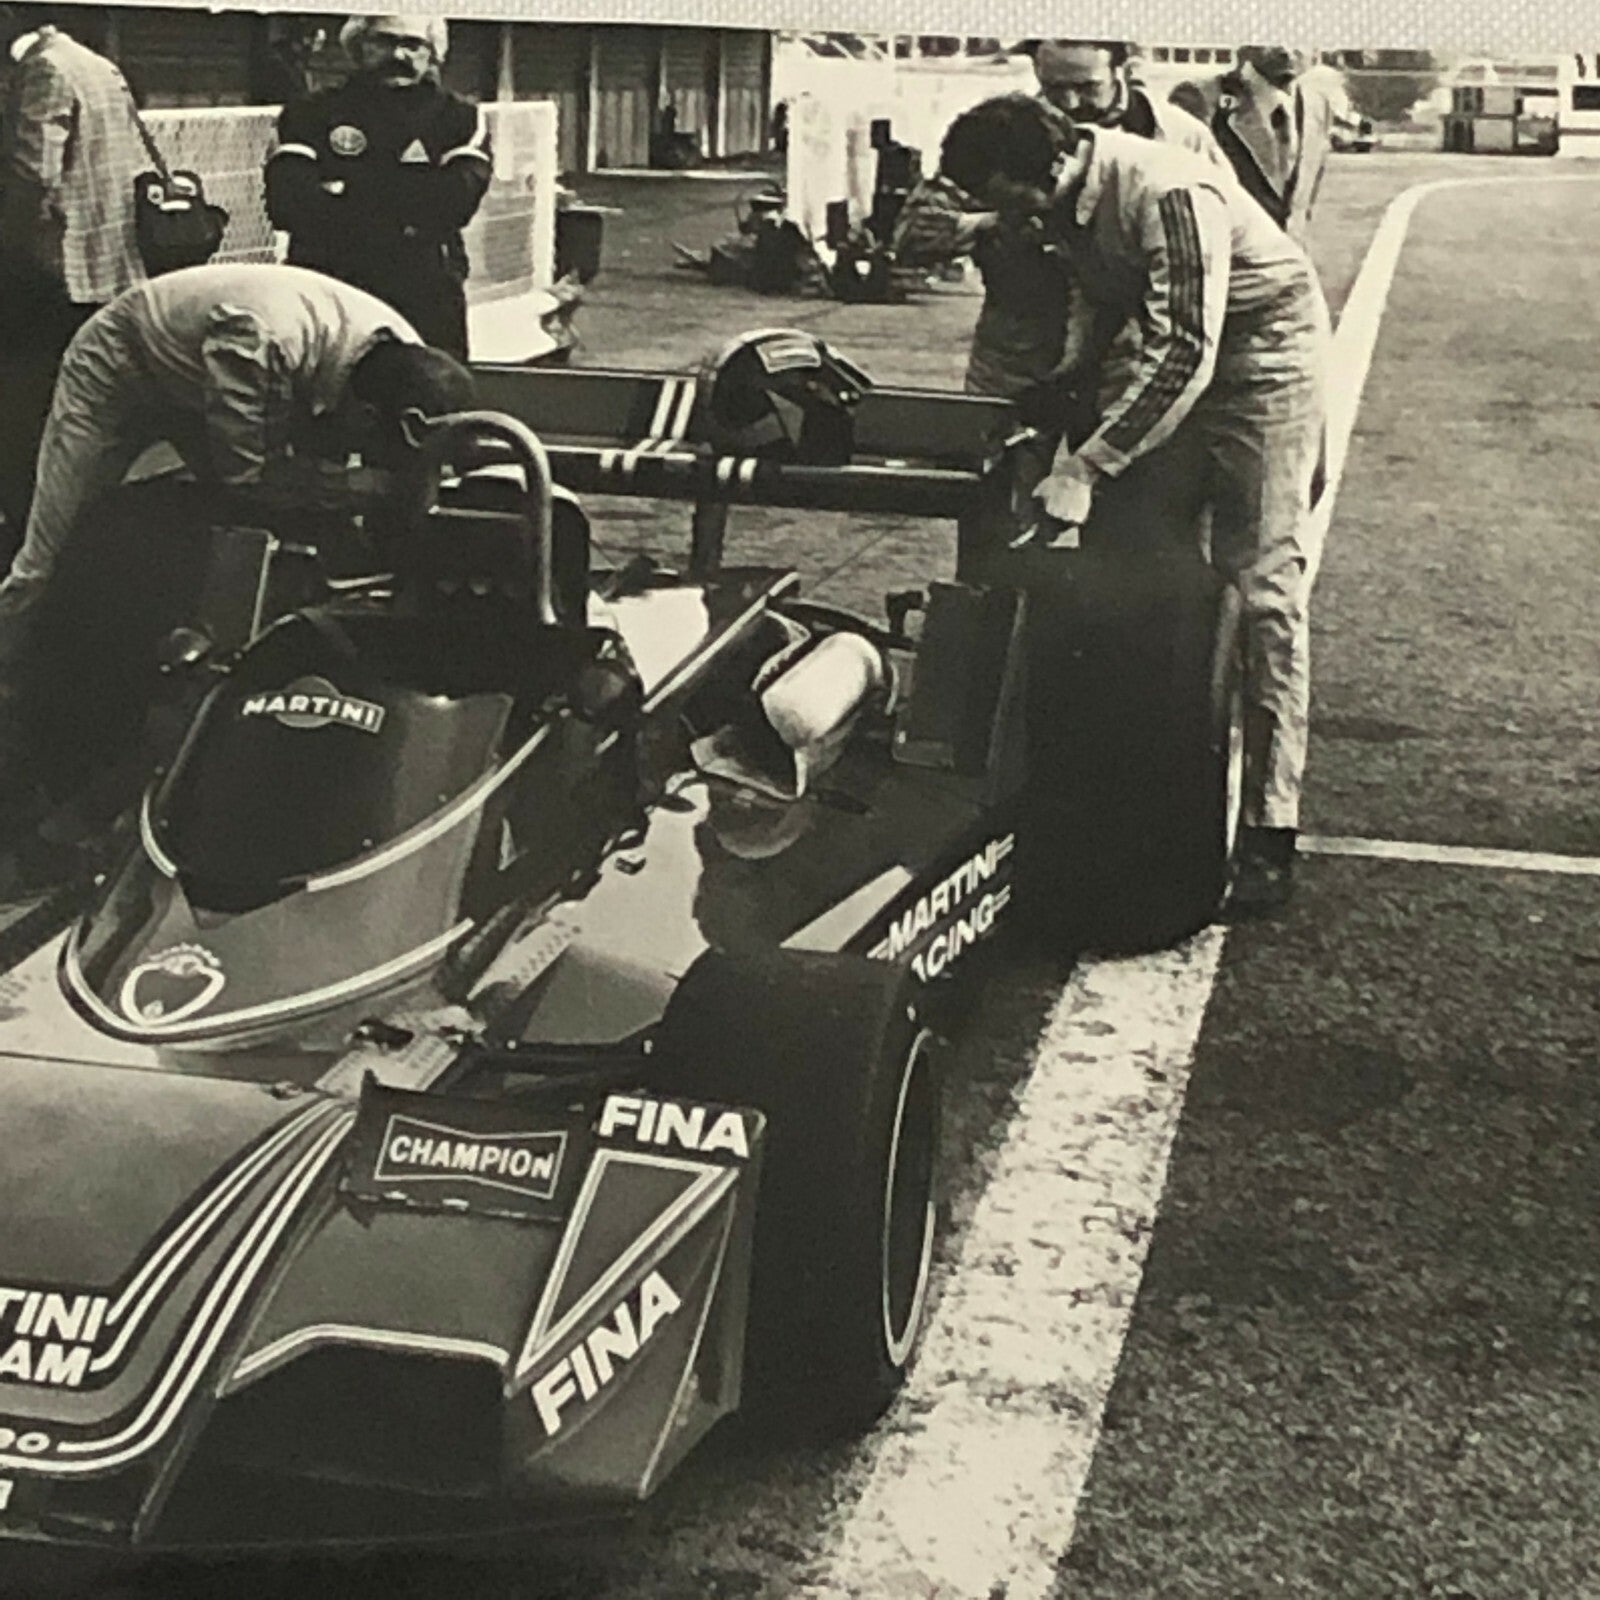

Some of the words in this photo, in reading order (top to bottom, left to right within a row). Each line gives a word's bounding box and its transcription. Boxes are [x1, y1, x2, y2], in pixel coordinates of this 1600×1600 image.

[242, 695, 376, 726] MARTINI
[888, 839, 999, 960] MARTINI
[389, 1135, 555, 1180] CHAMPION
[599, 1095, 750, 1158] FINA
[531, 1270, 682, 1437] FINA
